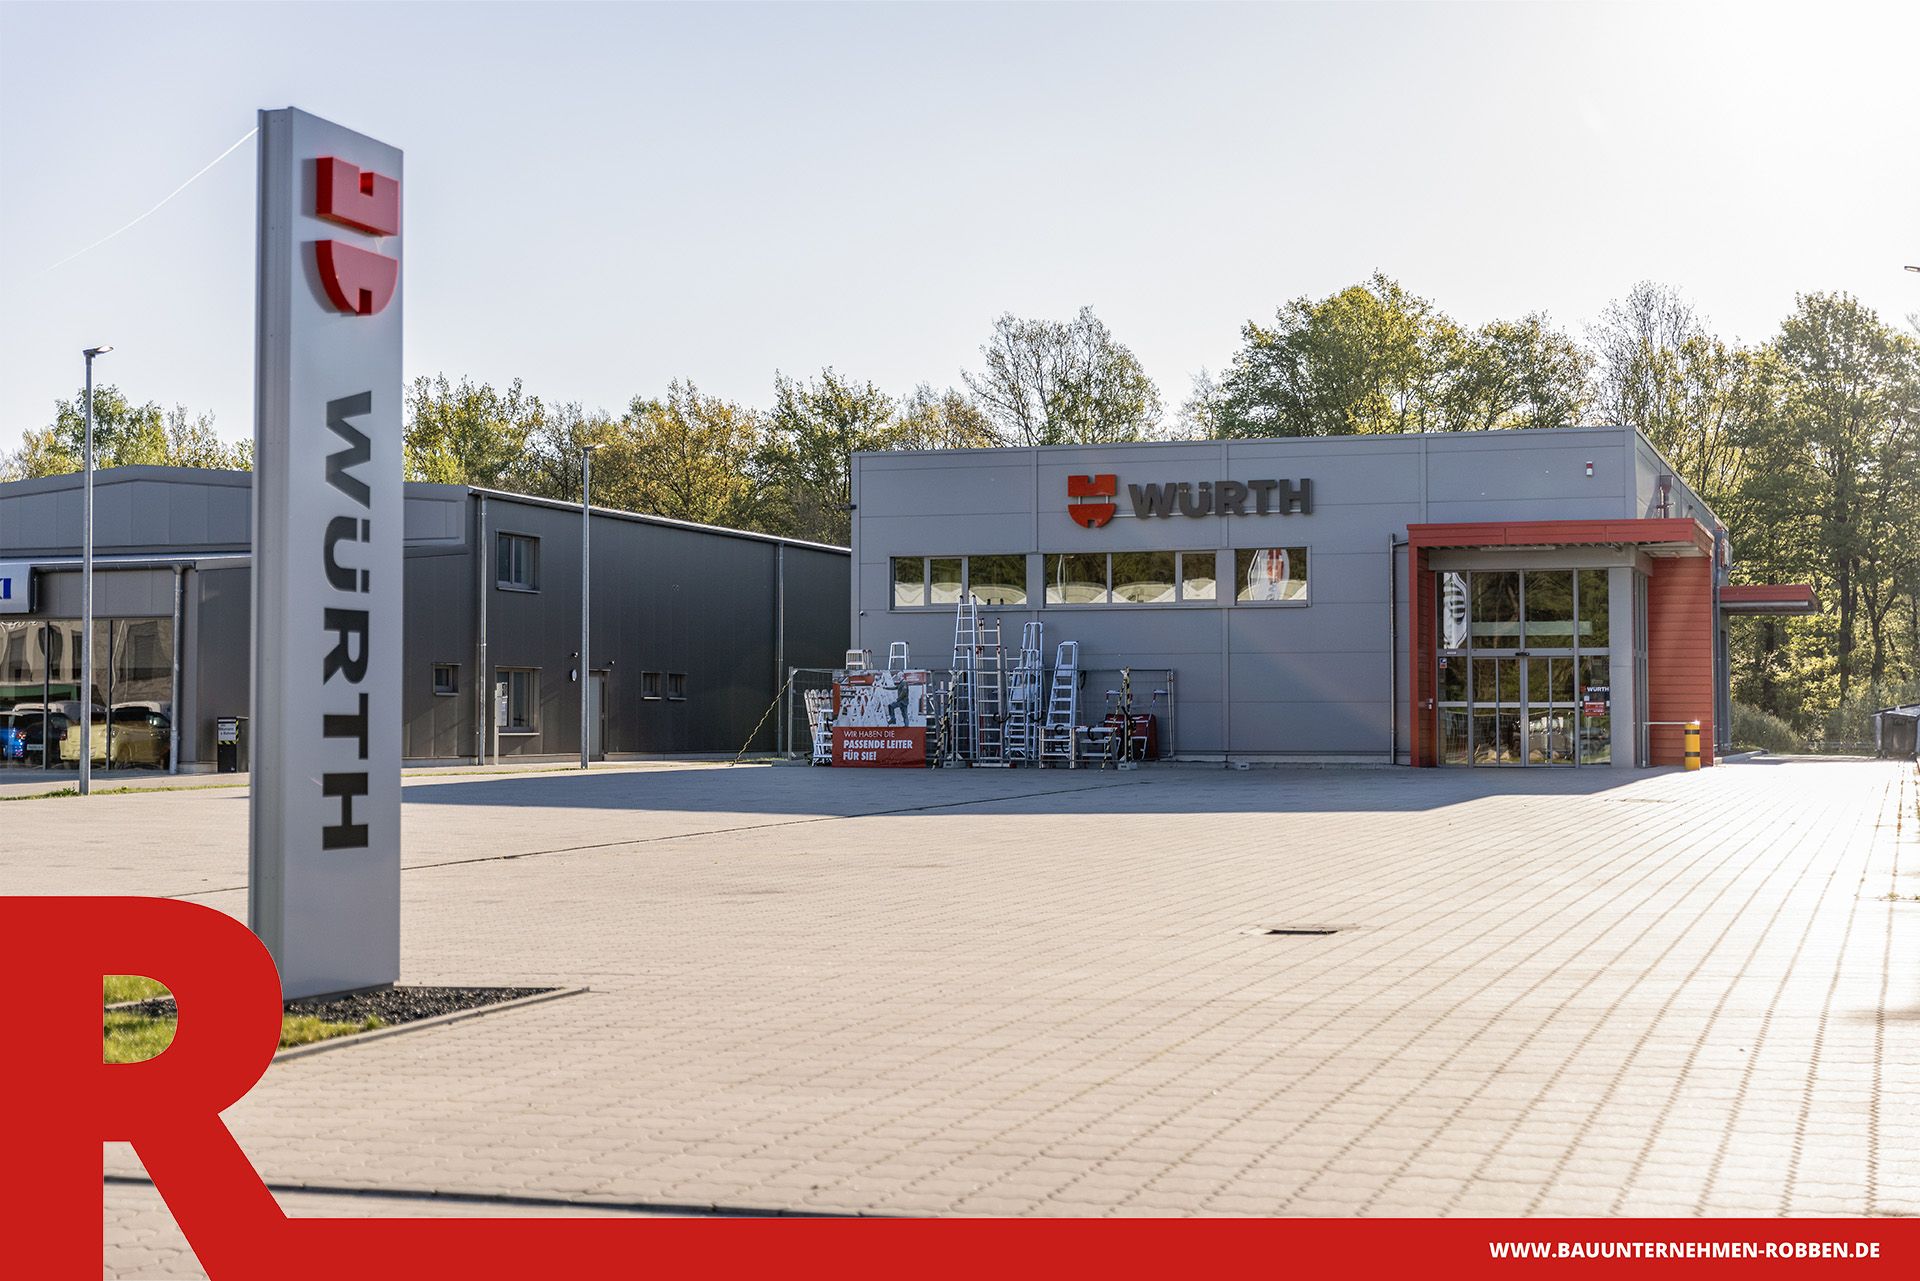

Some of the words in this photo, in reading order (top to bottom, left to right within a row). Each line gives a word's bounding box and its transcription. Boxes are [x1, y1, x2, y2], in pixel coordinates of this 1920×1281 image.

[1128, 478, 1313, 520] WÜRTH
[0, 577, 12, 600] I
[322, 390, 372, 850] WÜRTH
[843, 730, 857, 738] WIR
[858, 730, 883, 738] HABEN
[884, 730, 895, 738] DIE
[843, 740, 885, 749] PASSENDE
[886, 740, 913, 749] LEITER
[843, 750, 859, 761] FÜR
[861, 751, 877, 761] SIE!
